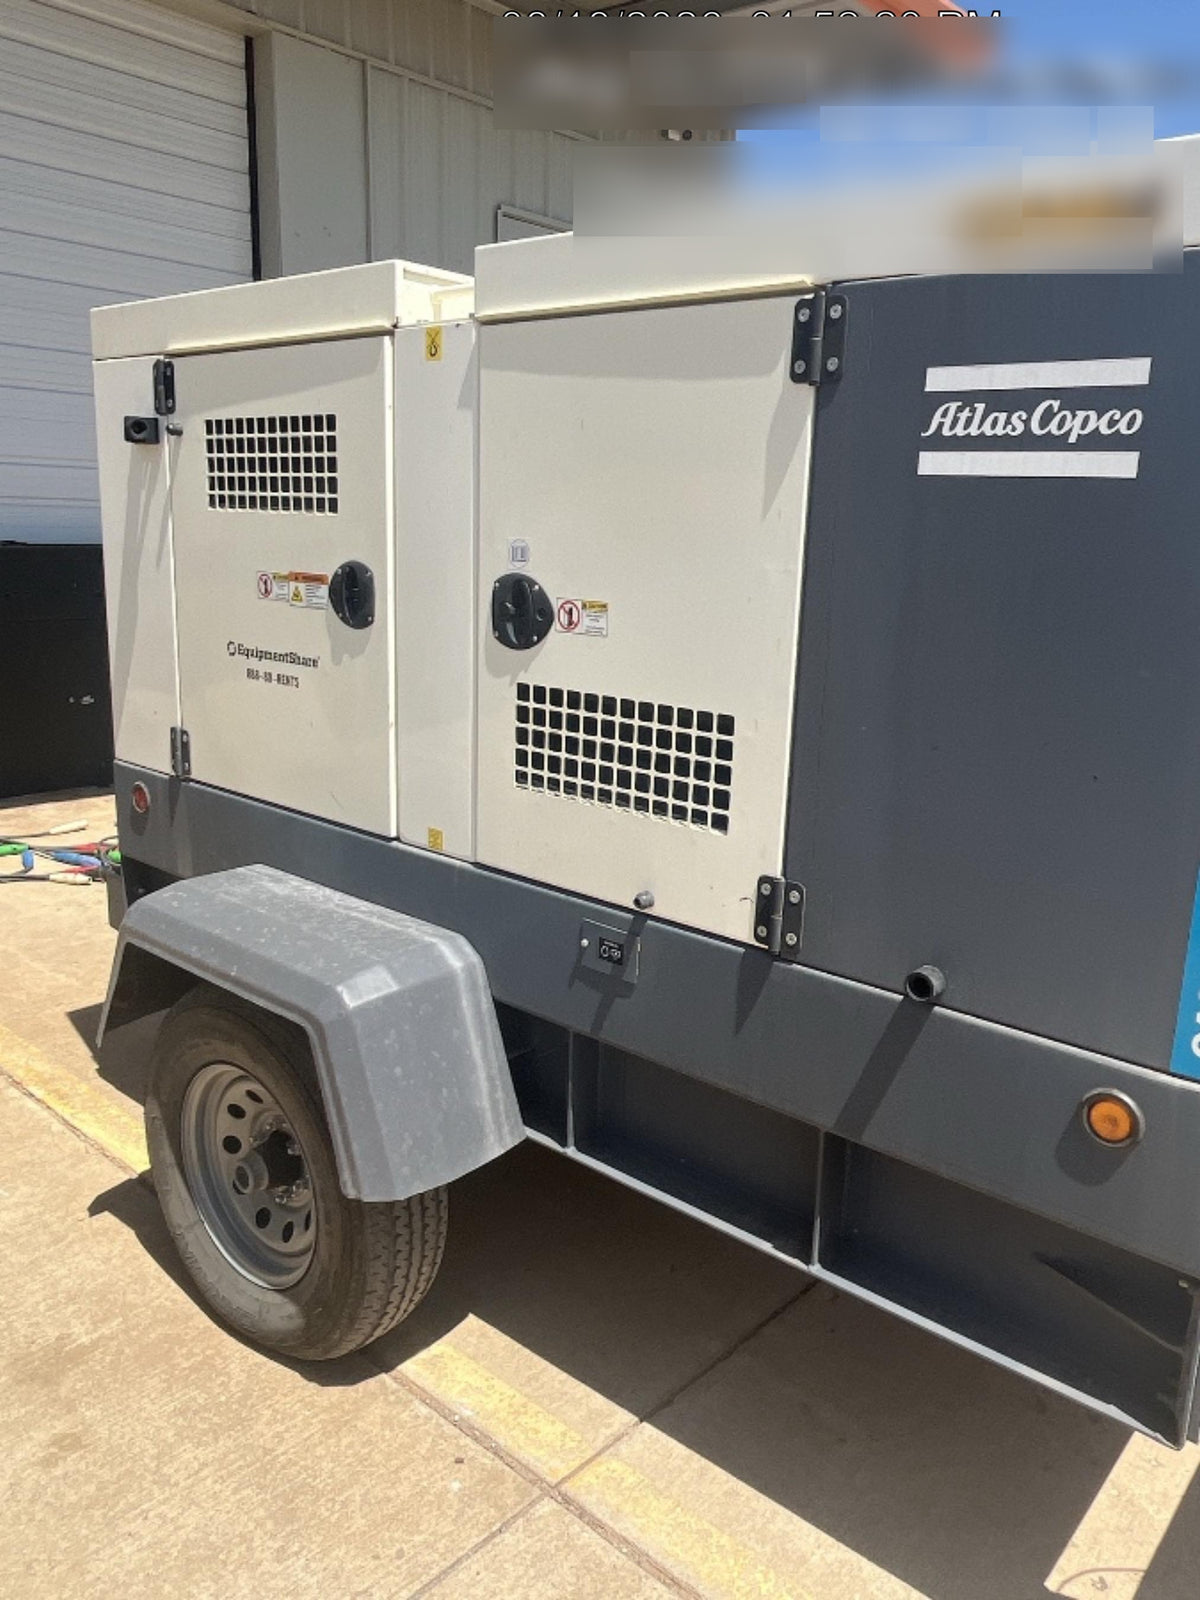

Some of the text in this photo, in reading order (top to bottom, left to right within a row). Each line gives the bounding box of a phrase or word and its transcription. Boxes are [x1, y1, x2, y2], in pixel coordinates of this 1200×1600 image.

[921, 399, 1143, 444] Atlas Copco
[238, 643, 318, 668] EquipmentShare
